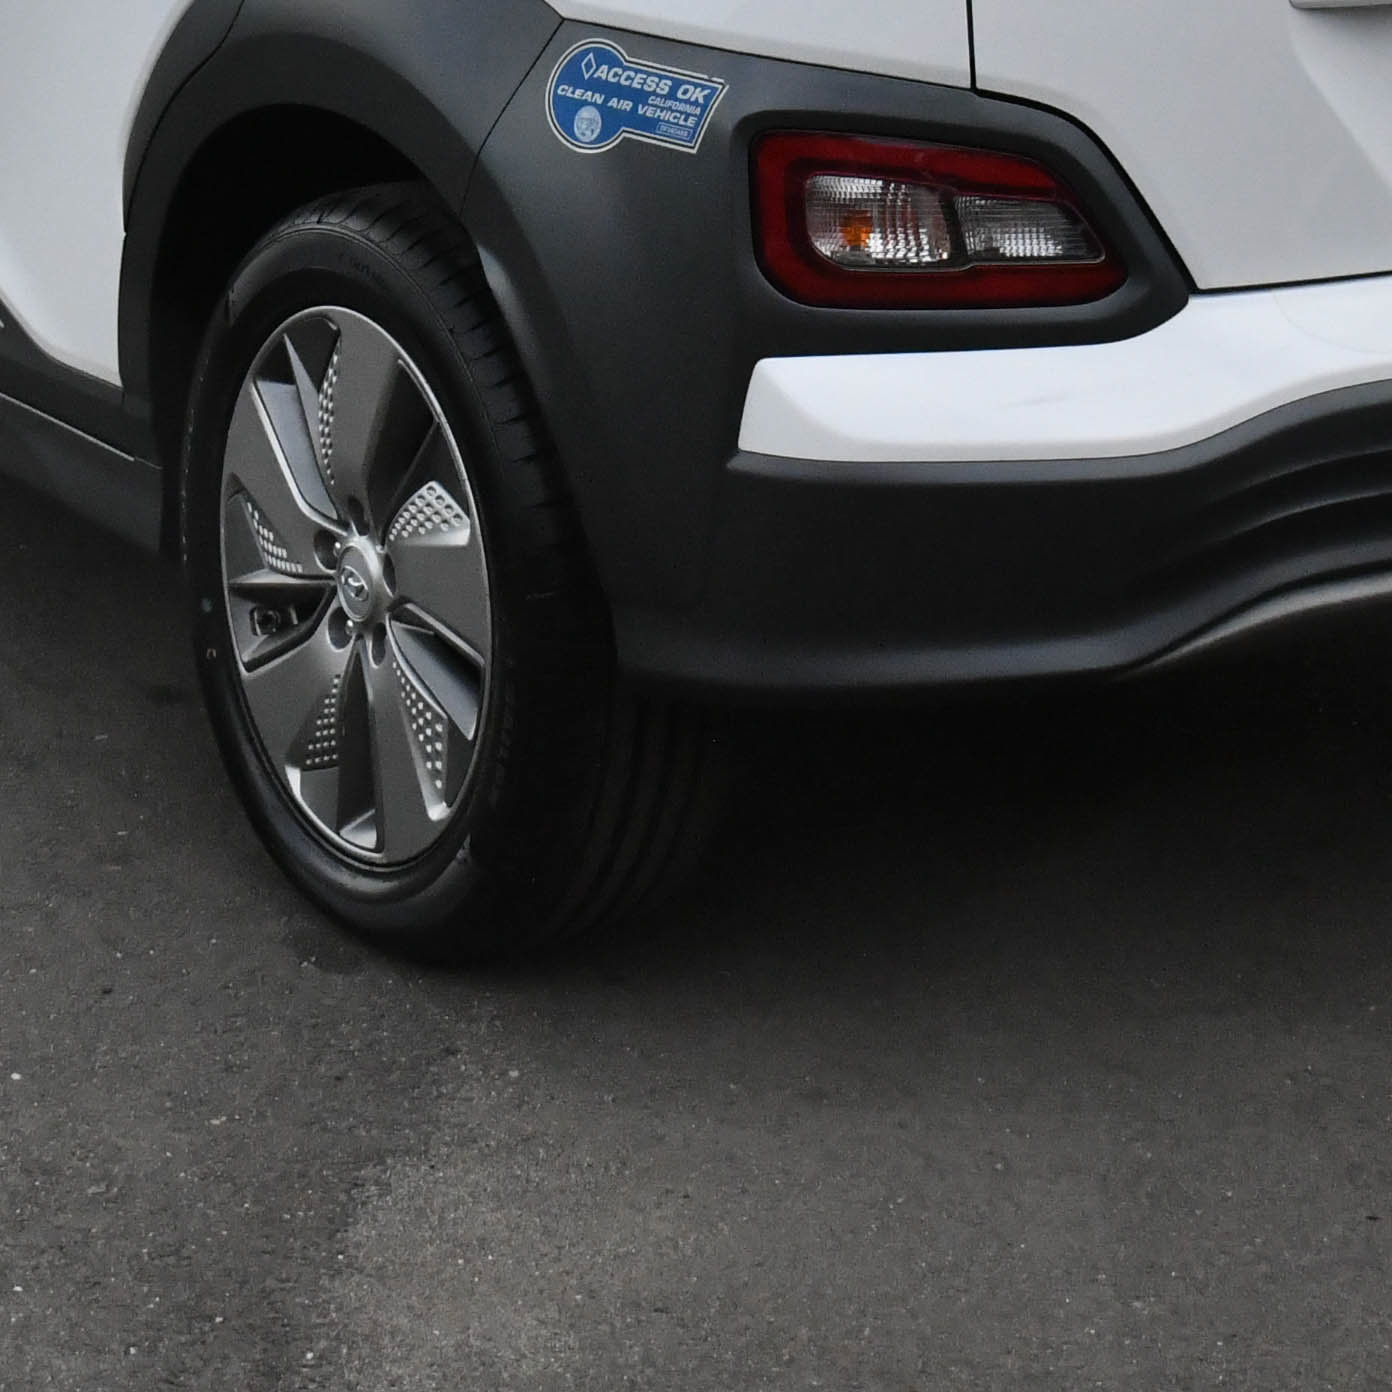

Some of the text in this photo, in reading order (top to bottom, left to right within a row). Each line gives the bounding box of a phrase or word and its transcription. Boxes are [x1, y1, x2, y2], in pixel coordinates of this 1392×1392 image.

[594, 64, 711, 104] ACCESS OK
[557, 84, 698, 128] CLEAN AIR VEHICLE
[648, 95, 701, 116] CALIFORNIA
